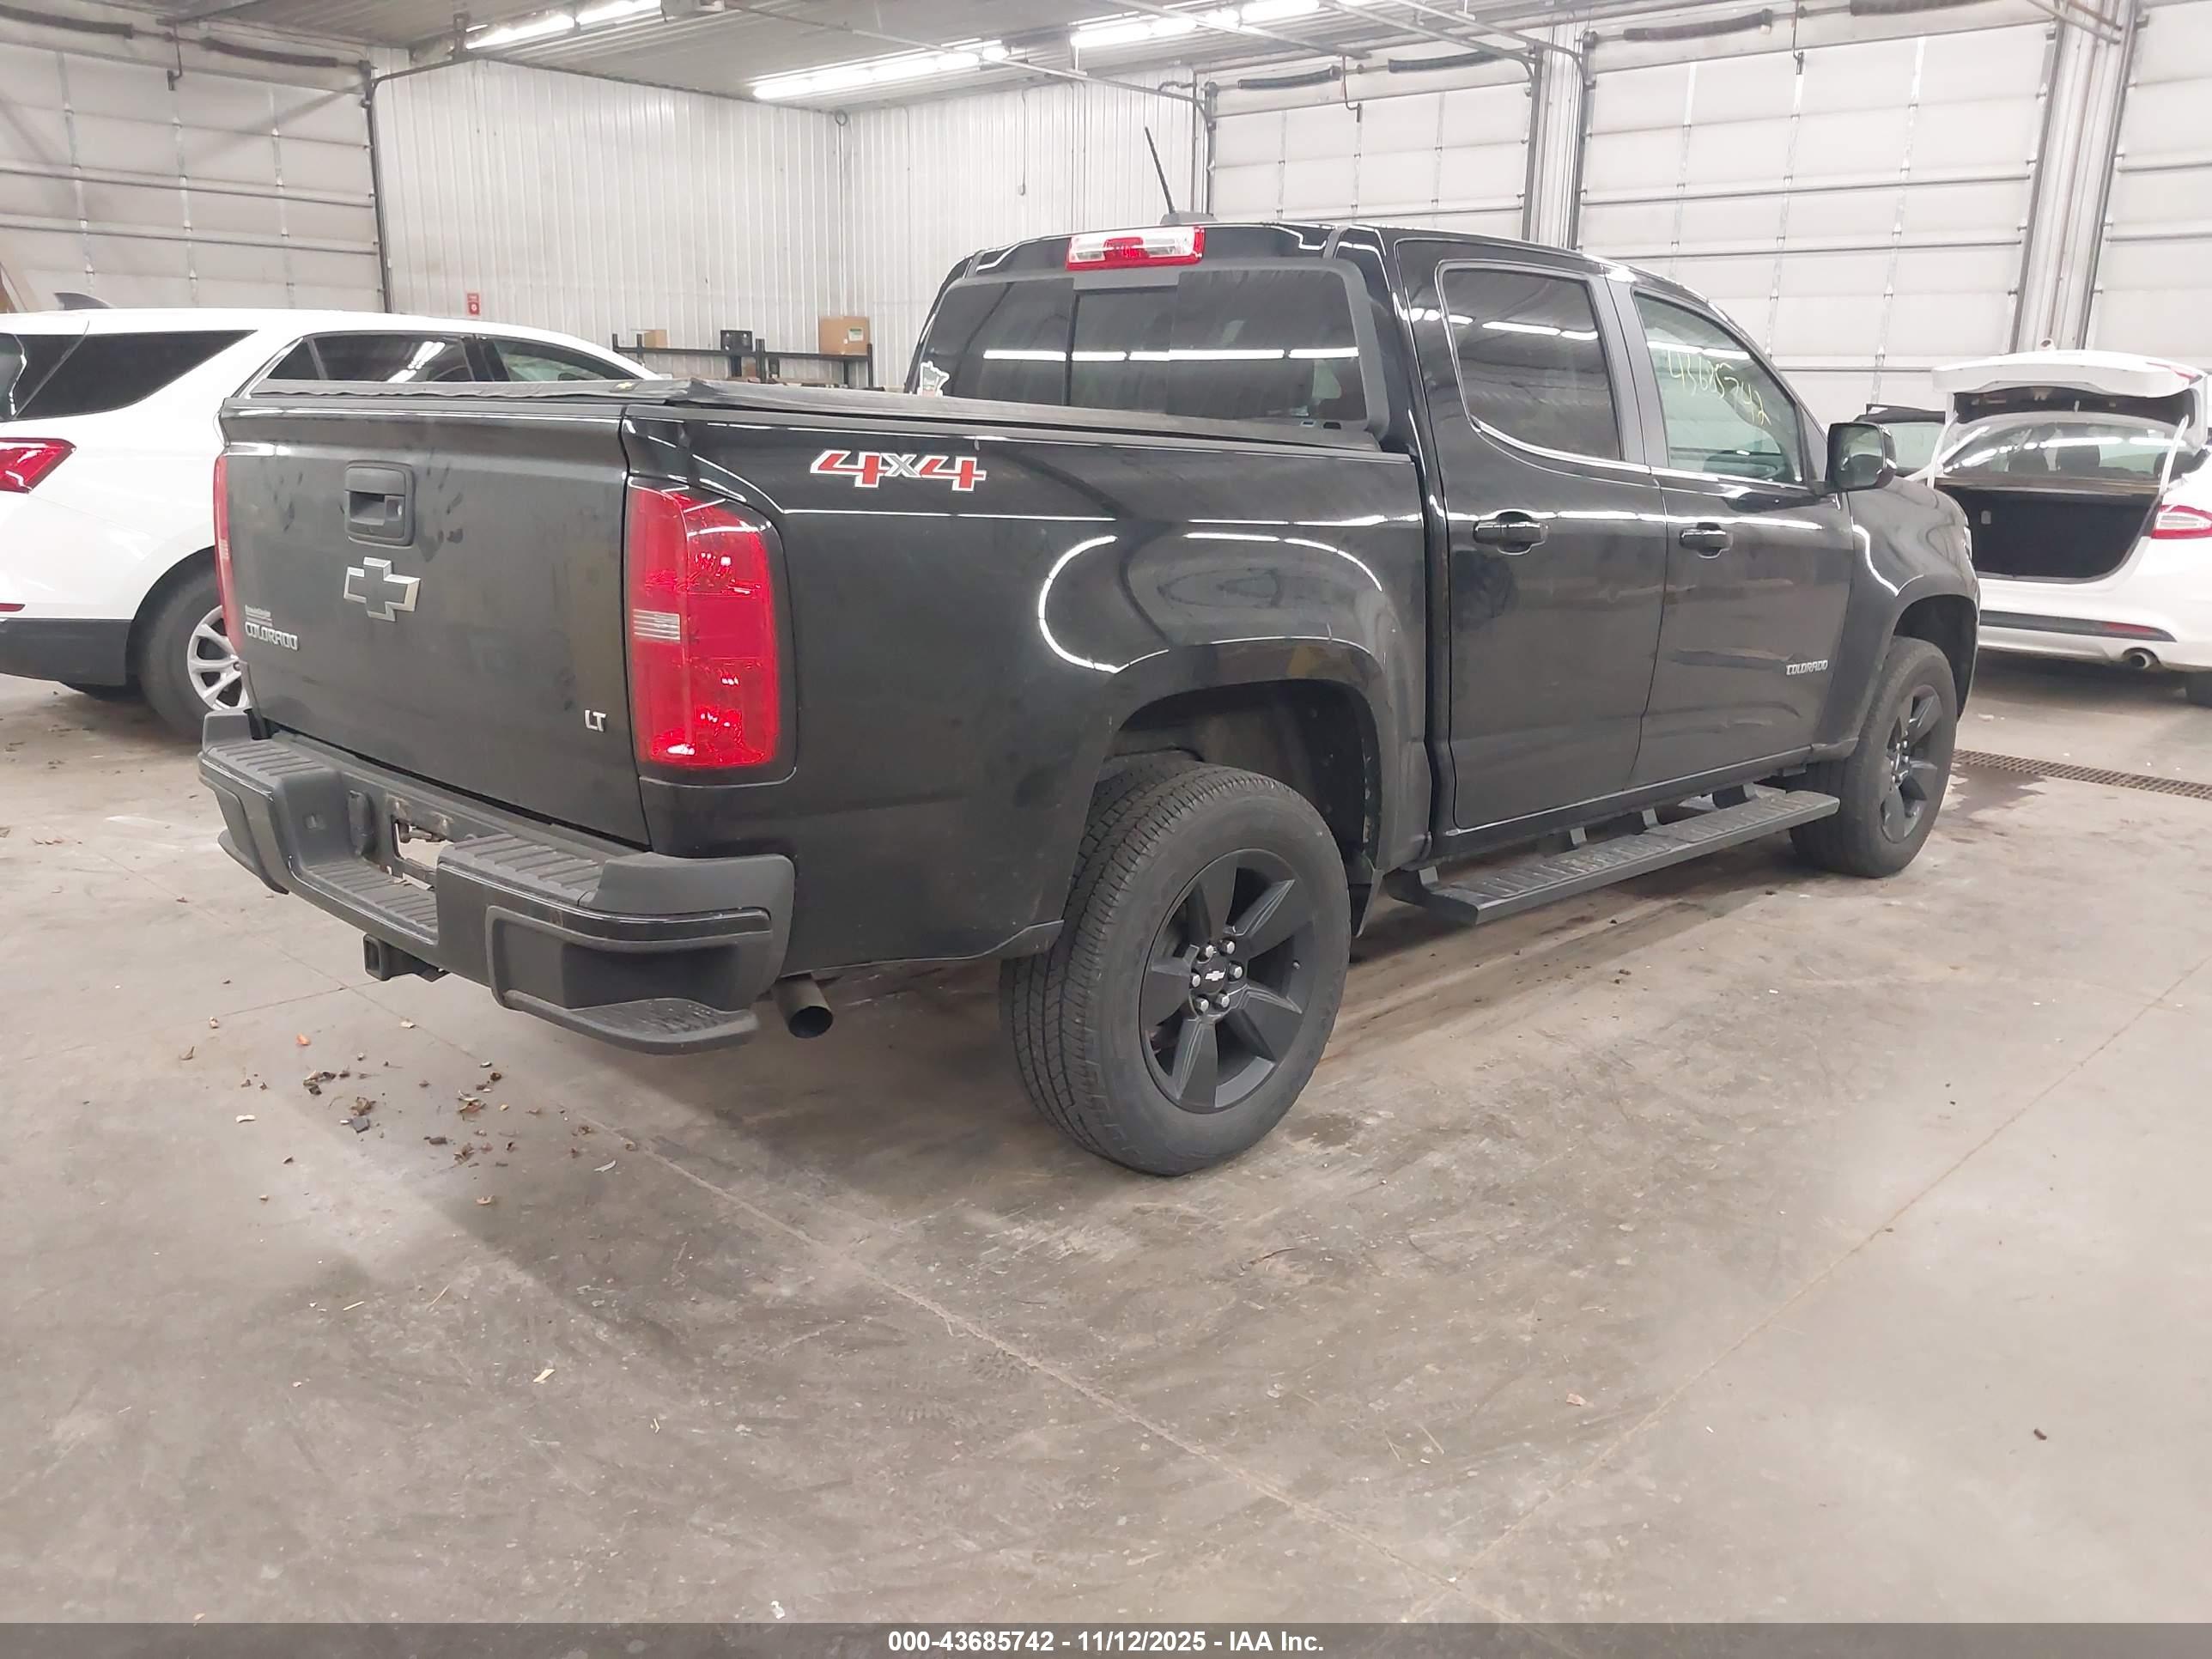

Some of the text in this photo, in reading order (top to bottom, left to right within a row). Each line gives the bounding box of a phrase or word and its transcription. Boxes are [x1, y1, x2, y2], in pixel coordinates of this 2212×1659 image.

[1667, 349, 1771, 426] 43685742
[245, 621, 298, 651] COLORADO
[1786, 659, 1828, 676] COLORADO
[585, 709, 606, 732] LT
